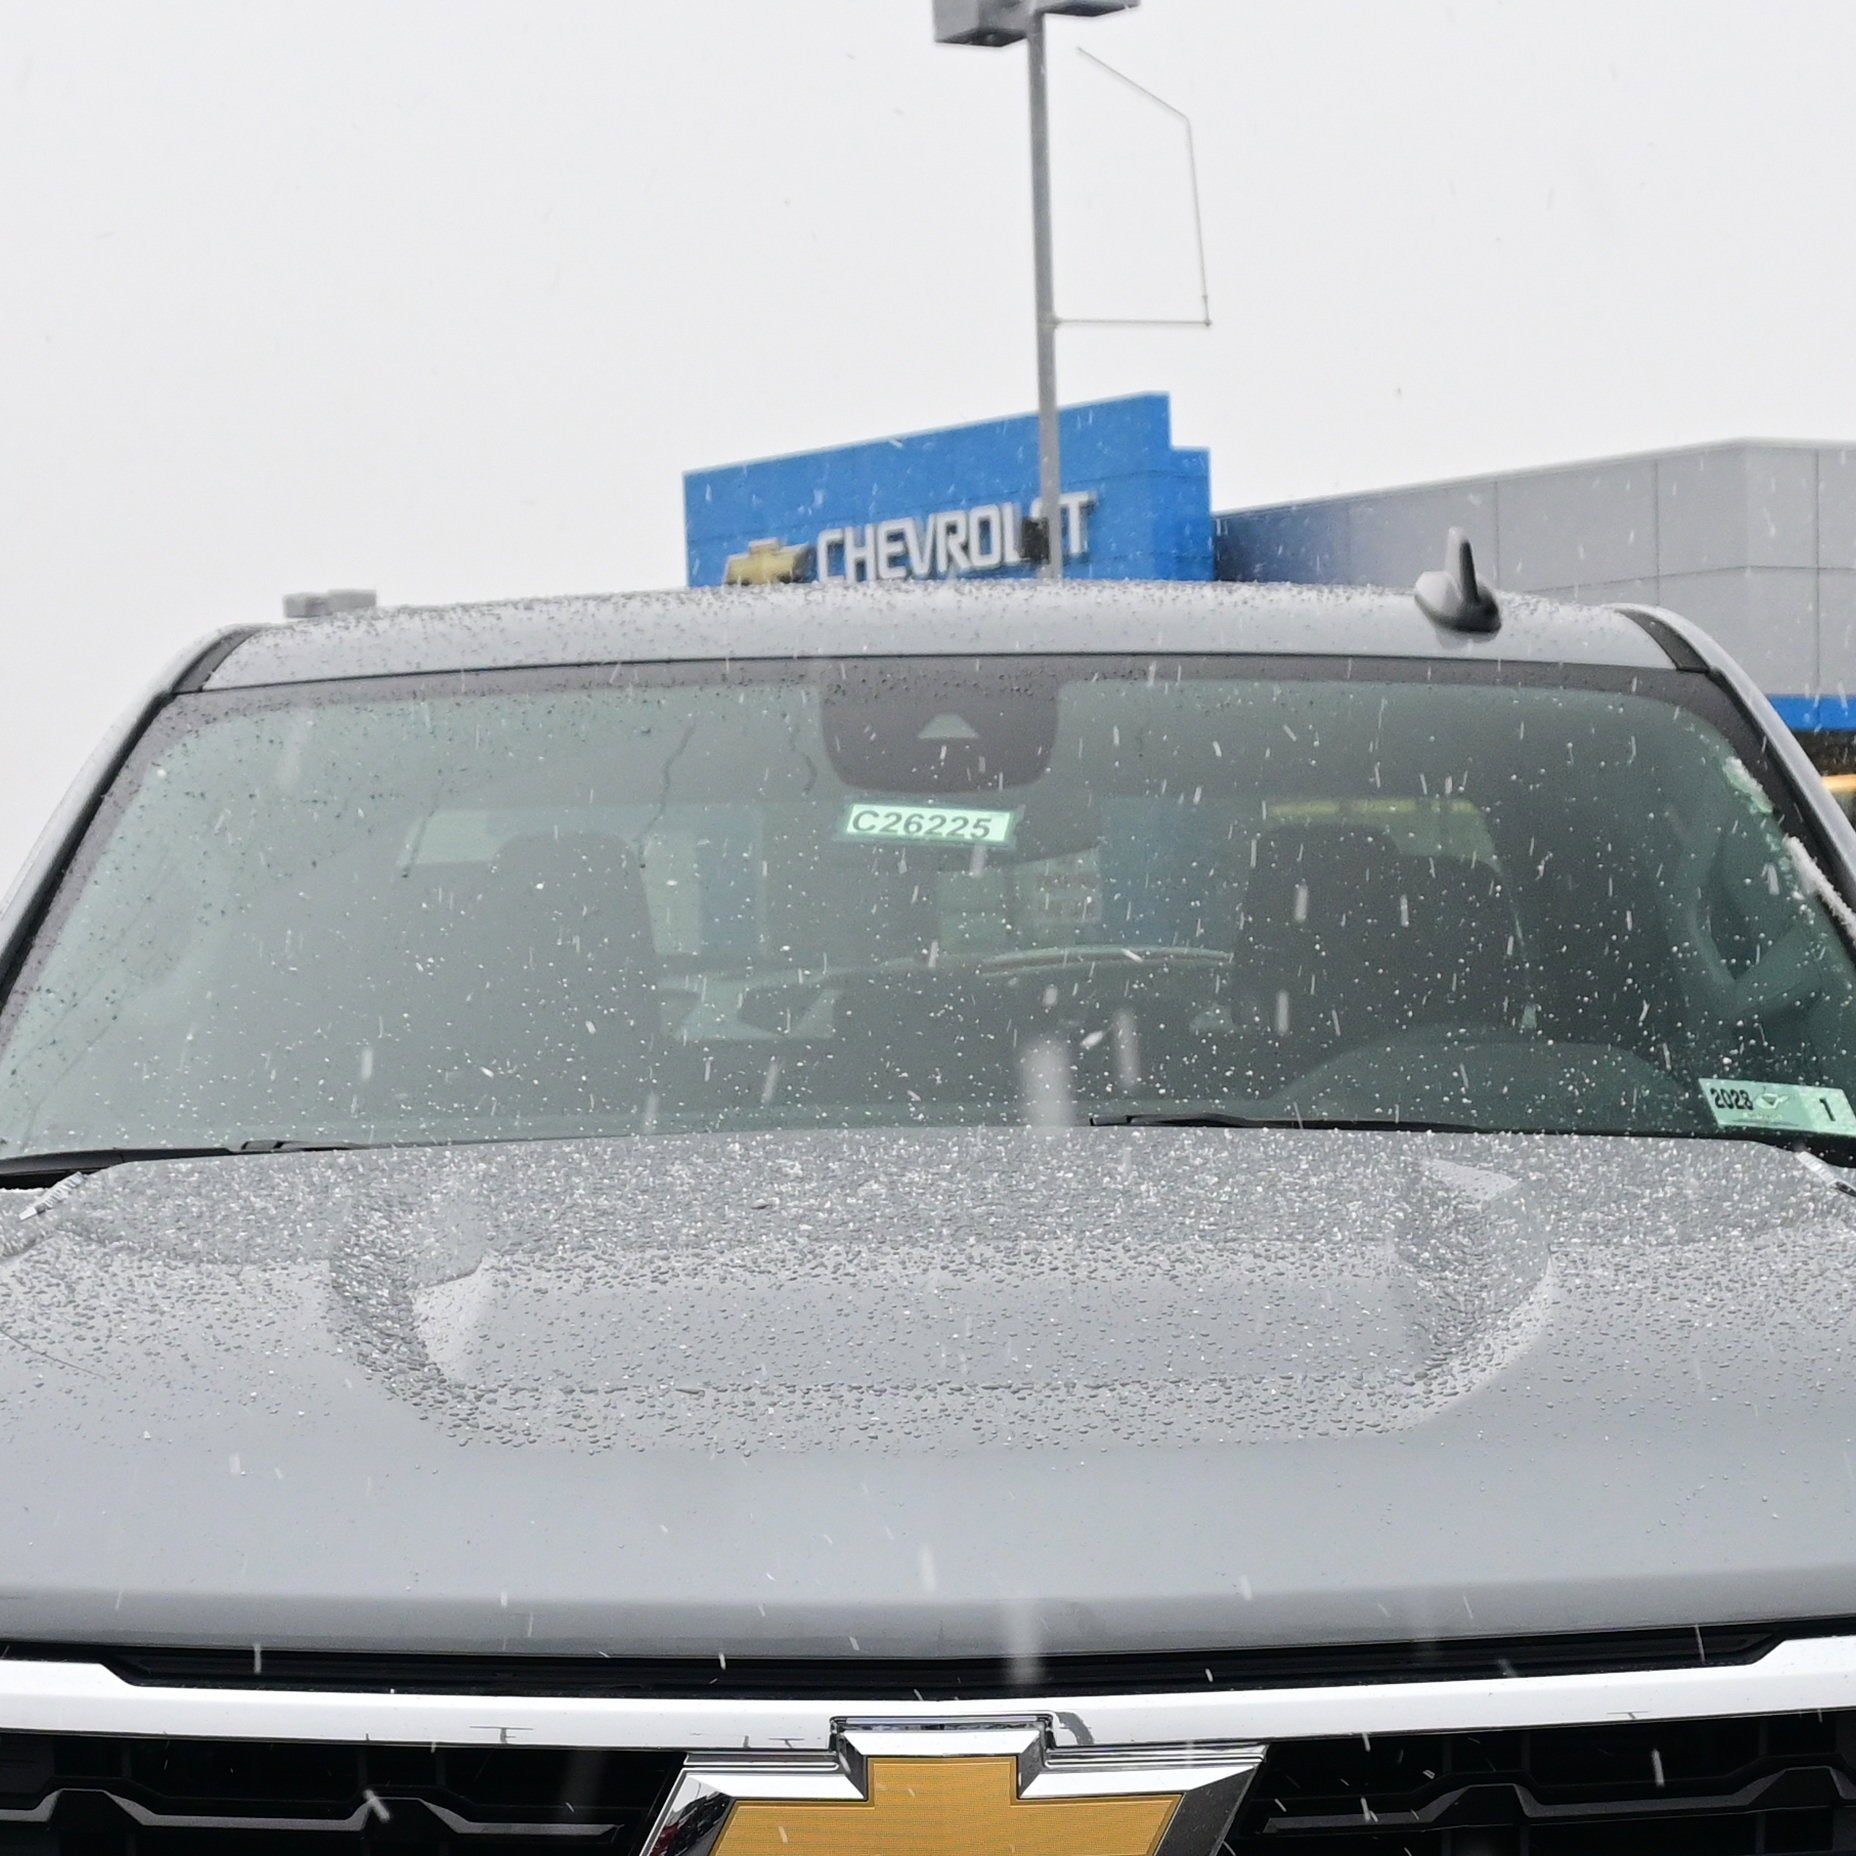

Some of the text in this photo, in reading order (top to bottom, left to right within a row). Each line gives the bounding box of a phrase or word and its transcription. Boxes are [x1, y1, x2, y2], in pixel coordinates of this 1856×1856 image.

[816, 490, 1095, 583] CHEVROLT
[852, 810, 993, 840] C26225
[1709, 1087, 1836, 1122] 2028 1
